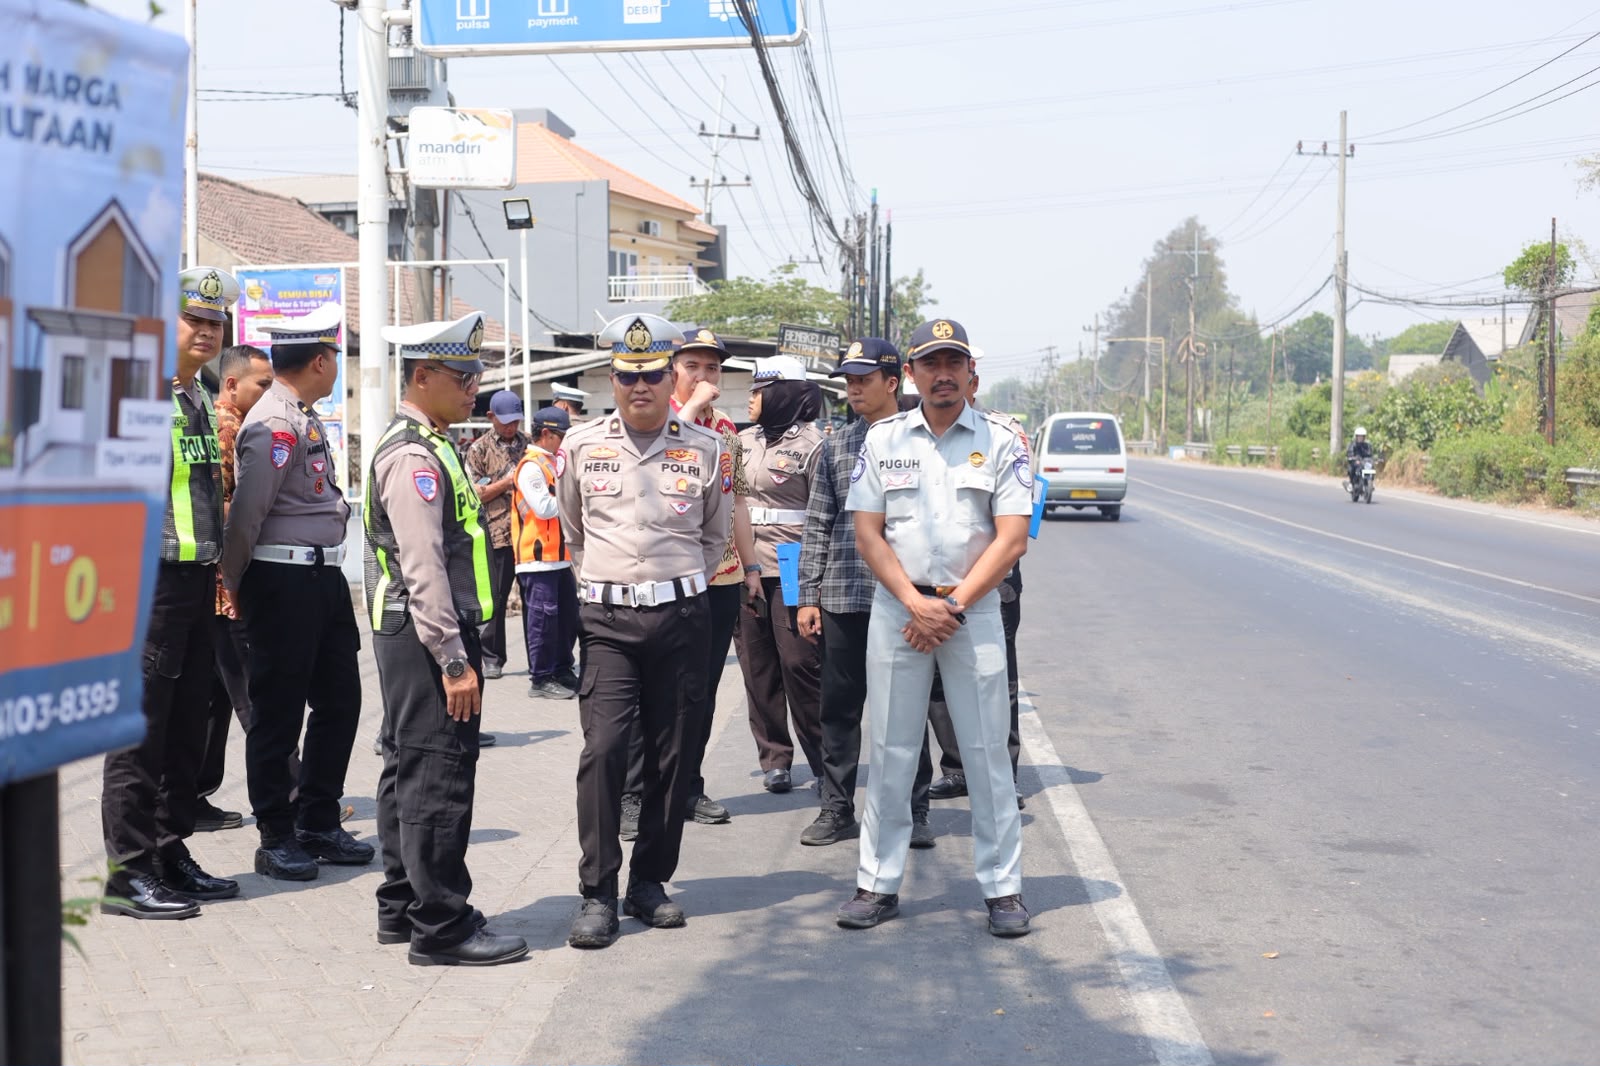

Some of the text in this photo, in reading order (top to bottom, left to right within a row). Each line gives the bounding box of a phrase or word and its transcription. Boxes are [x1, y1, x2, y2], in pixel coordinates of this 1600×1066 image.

[627, 5, 659, 16] DEBIT
[456, 20, 491, 31] pulsa
[528, 16, 579, 28] payment
[0, 104, 114, 153] UTAAN
[418, 140, 481, 154] mandiri
[784, 329, 840, 348] BENGKEL LAS
[775, 449, 802, 460] POLRI
[584, 462, 621, 473] HERU
[661, 463, 700, 477] POLRI
[879, 459, 921, 471] PUGUH
